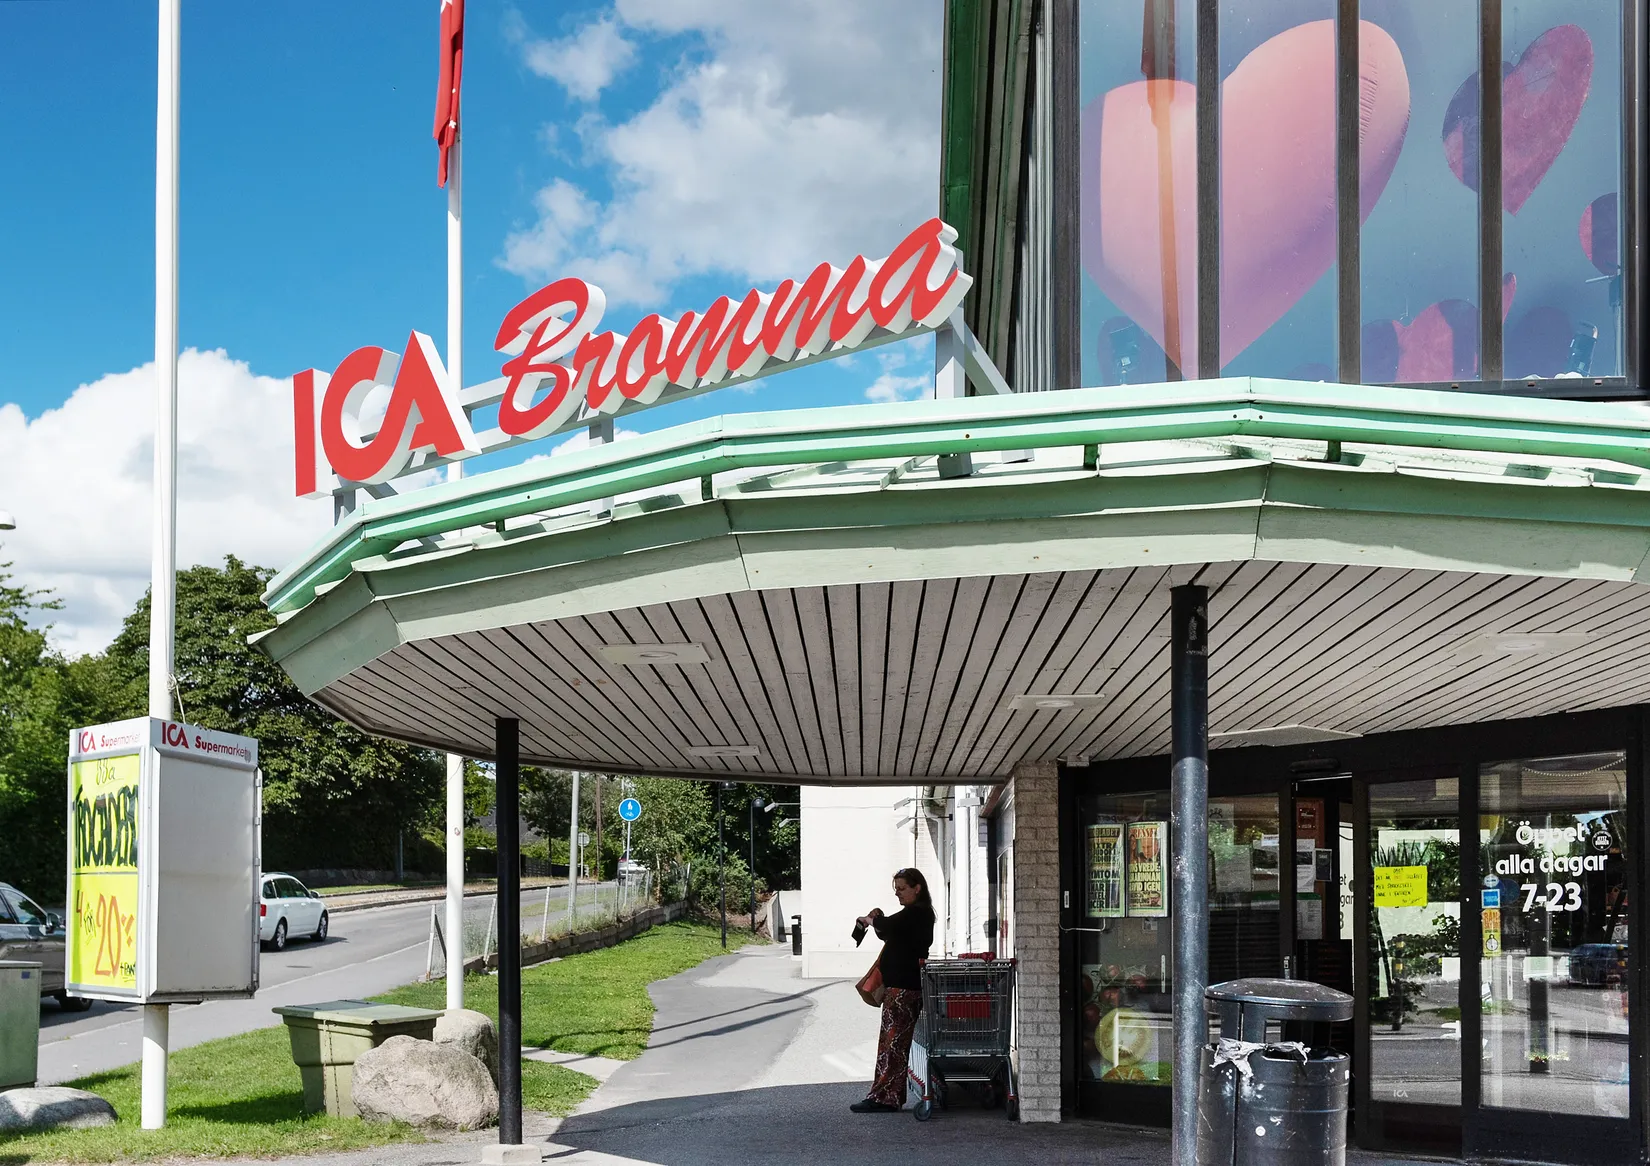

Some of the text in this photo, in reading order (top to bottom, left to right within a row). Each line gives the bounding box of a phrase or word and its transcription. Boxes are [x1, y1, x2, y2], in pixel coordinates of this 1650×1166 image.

[293, 218, 960, 497] ICA Bromma
[78, 731, 96, 753] ICA
[162, 722, 248, 758] ICA Supermarket
[1516, 820, 1585, 849] Öppet
[1495, 854, 1608, 877] alla dagar
[1520, 882, 1582, 912] 7-23
